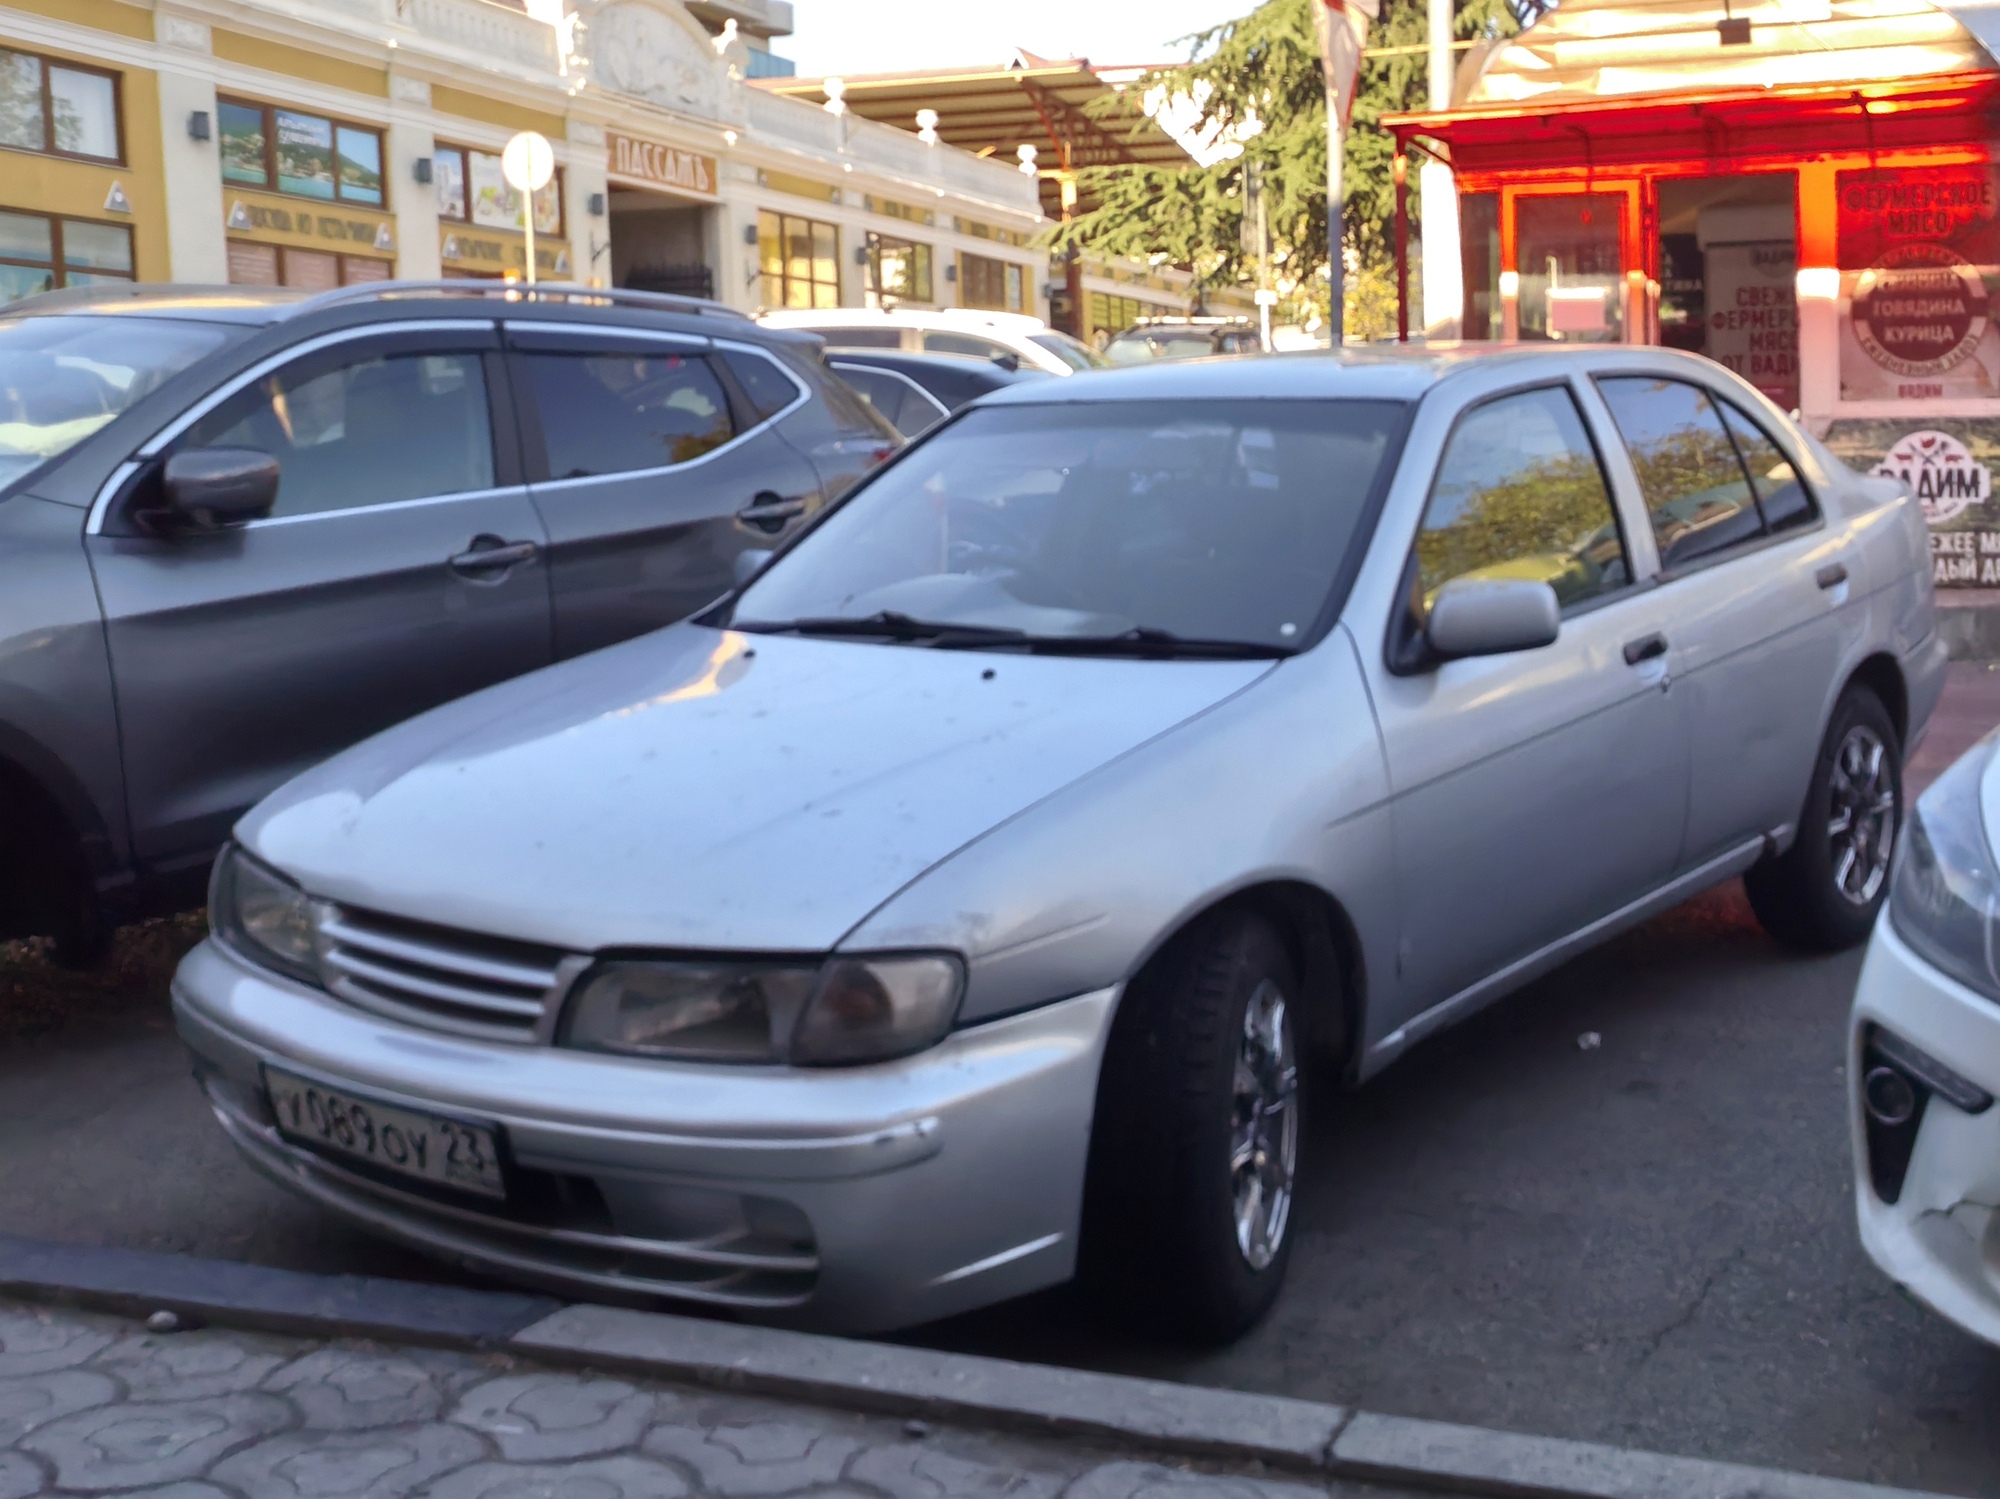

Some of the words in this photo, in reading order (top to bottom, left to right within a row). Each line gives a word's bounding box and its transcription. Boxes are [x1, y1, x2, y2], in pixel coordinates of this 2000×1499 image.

[1847, 181, 1992, 211] ФЕРМЕРСКОЕ
[1888, 210, 1948, 234] МЯСО
[1884, 324, 1956, 344] КУРИЦА
[1879, 467, 1980, 504] ДИМ
